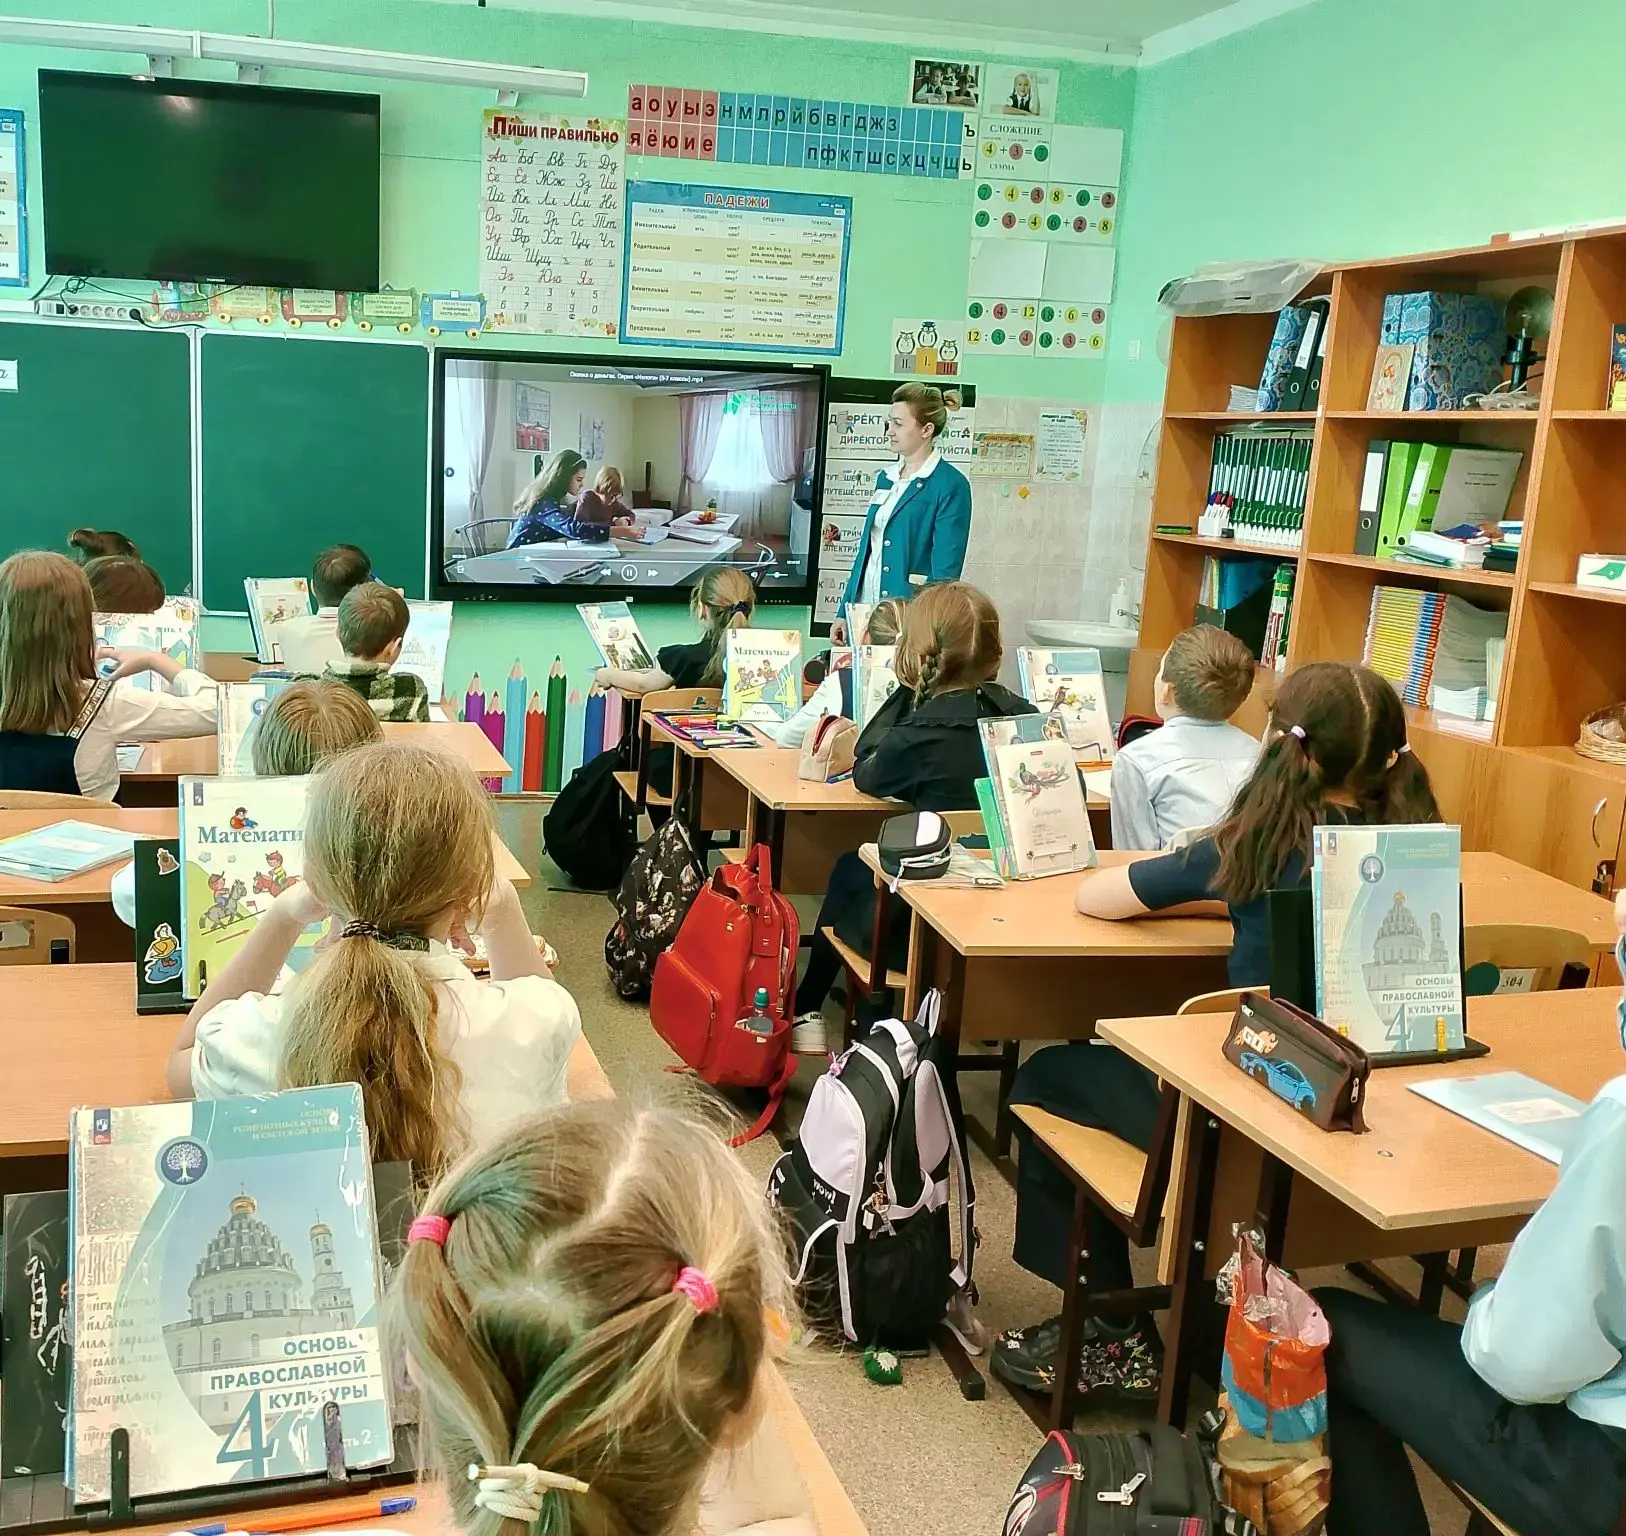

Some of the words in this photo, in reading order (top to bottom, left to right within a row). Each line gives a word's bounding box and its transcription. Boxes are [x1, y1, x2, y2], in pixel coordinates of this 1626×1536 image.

[990, 124, 1042, 136] СЛОЖЕНИЕ
[704, 192, 770, 208] ПАДЕЖИ
[198, 826, 303, 844] Математи
[1416, 977, 1454, 986] ОСНОВЫ
[1382, 990, 1454, 1002] ПРАВОСЛАВНОЙ
[1408, 1004, 1454, 1014] КУЛЬТУРЫ
[1385, 1004, 1412, 1052] 4
[210, 1356, 366, 1390] ПРАВОСЛАВНОЙ
[216, 1389, 277, 1478] 4
